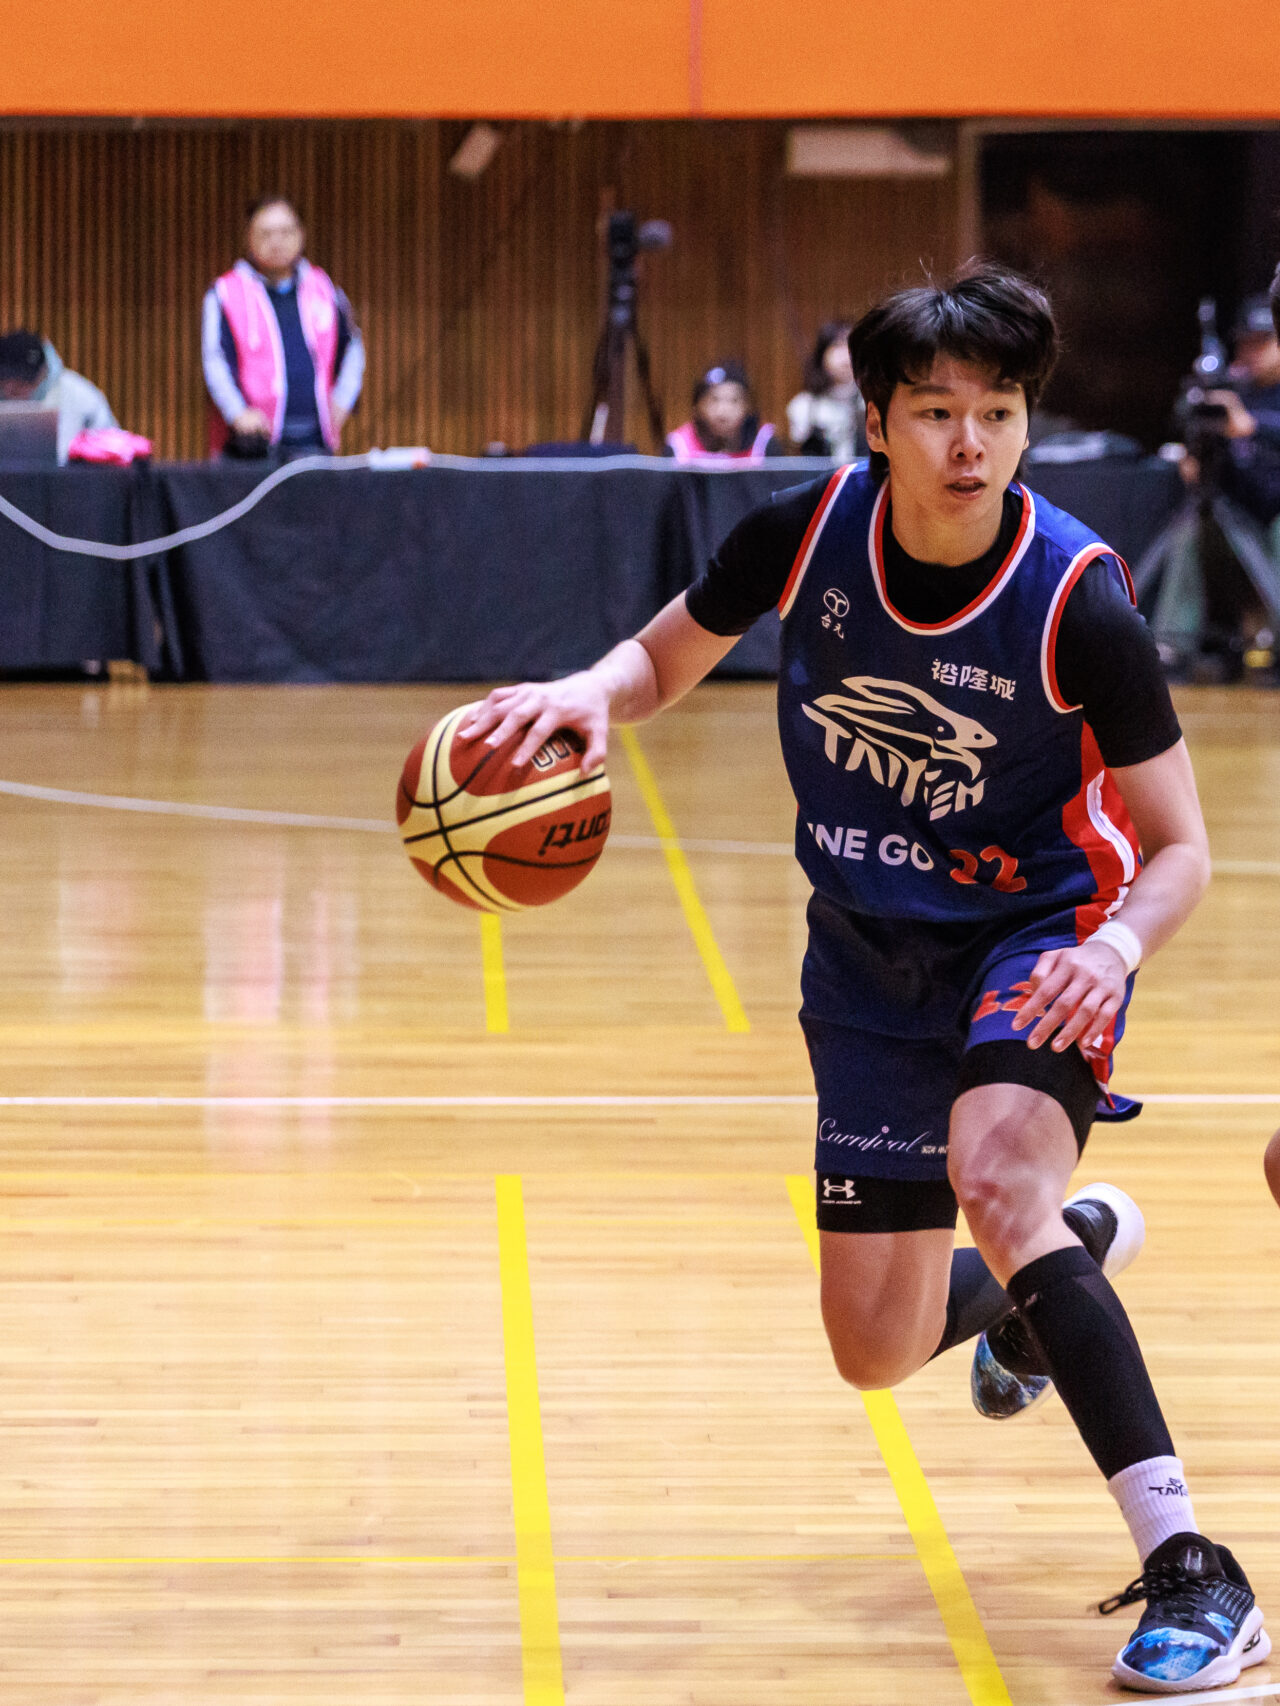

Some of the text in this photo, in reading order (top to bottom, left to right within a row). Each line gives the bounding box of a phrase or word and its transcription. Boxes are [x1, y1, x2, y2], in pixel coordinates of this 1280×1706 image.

[821, 614, 845, 640] 台元
[931, 658, 1017, 701] 裕隆城
[538, 811, 610, 857] onti
[807, 822, 935, 871] NE GO
[950, 845, 1028, 893] 22
